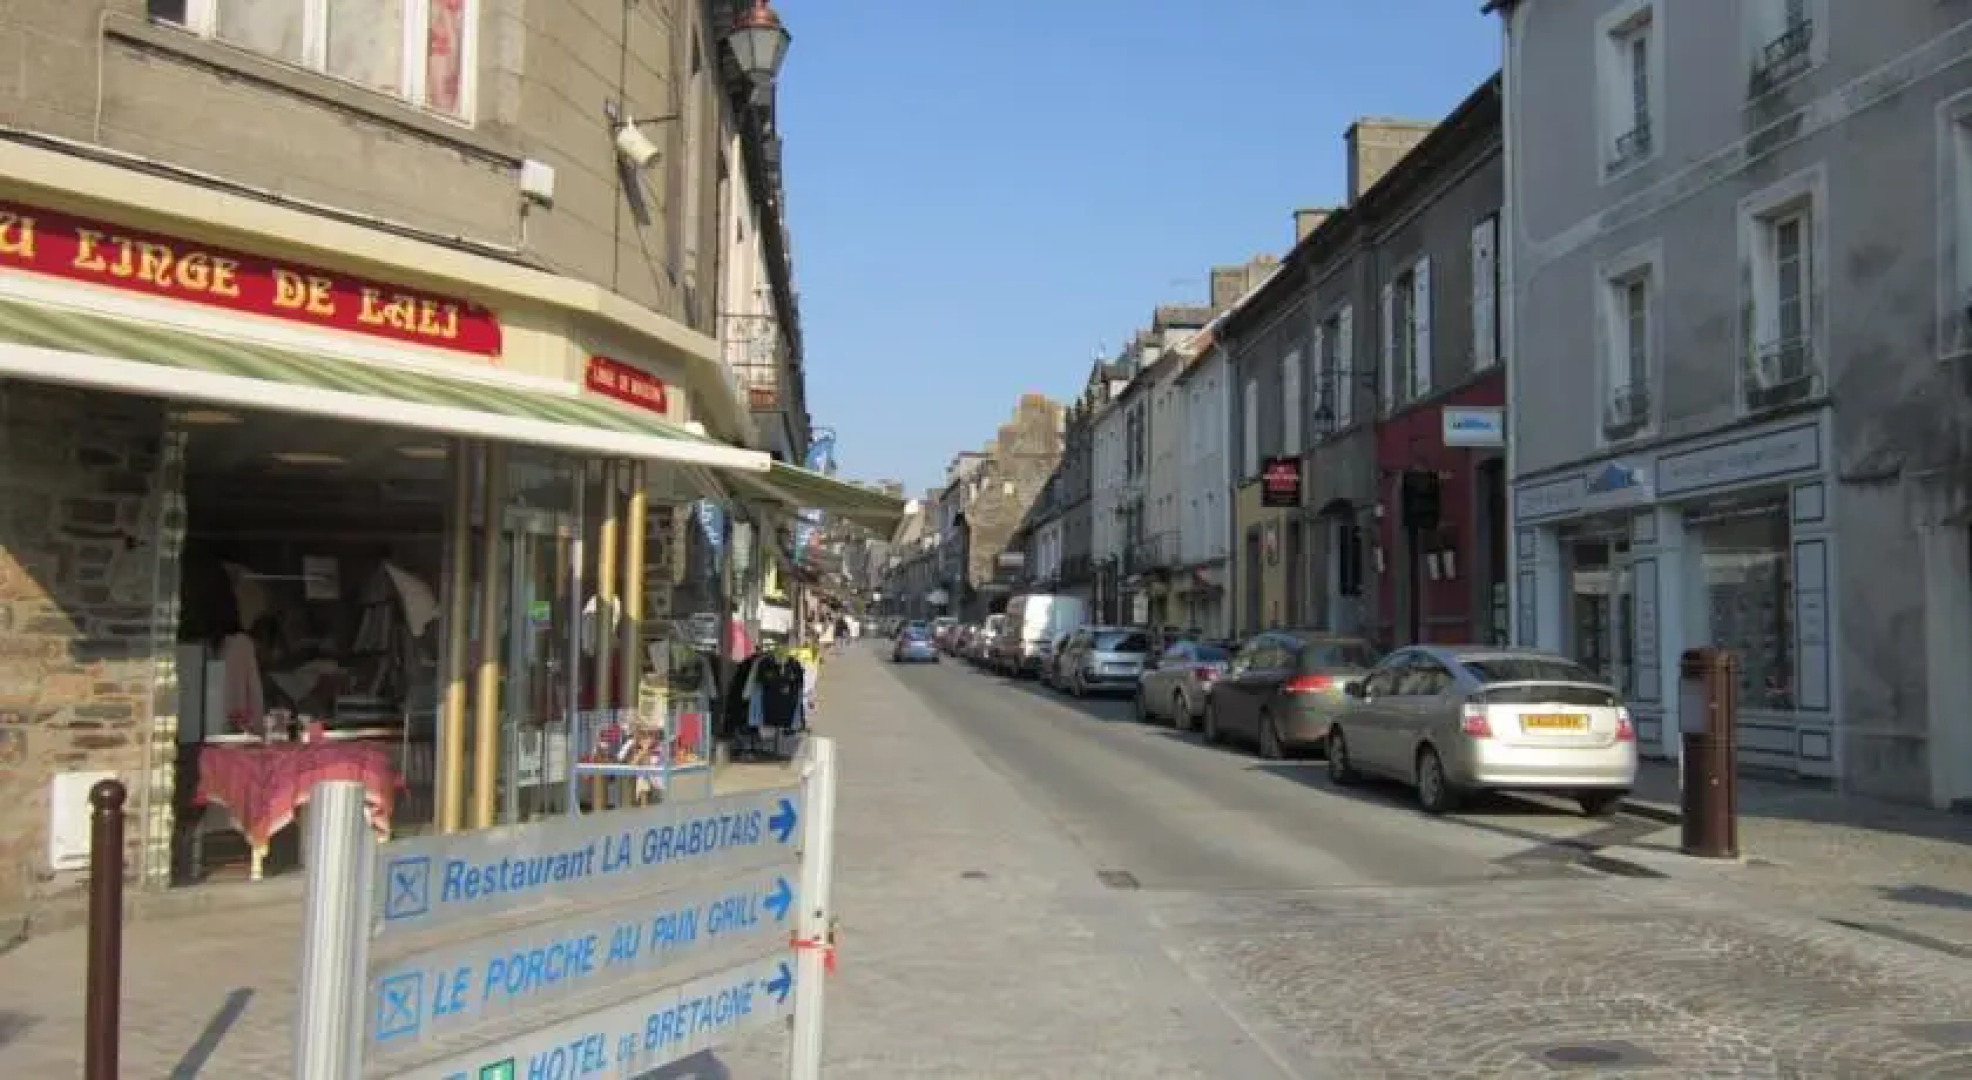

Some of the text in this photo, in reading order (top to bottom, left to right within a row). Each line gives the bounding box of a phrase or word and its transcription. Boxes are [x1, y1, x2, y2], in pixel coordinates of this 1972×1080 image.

[74, 228, 240, 297] LINGE
[272, 269, 336, 317] DE
[441, 810, 762, 902] Restaurant LA GRABOTAIS
[433, 894, 758, 1016] LE PORCHE AU PAIN GRILL
[644, 980, 754, 1050] BRETAGNE
